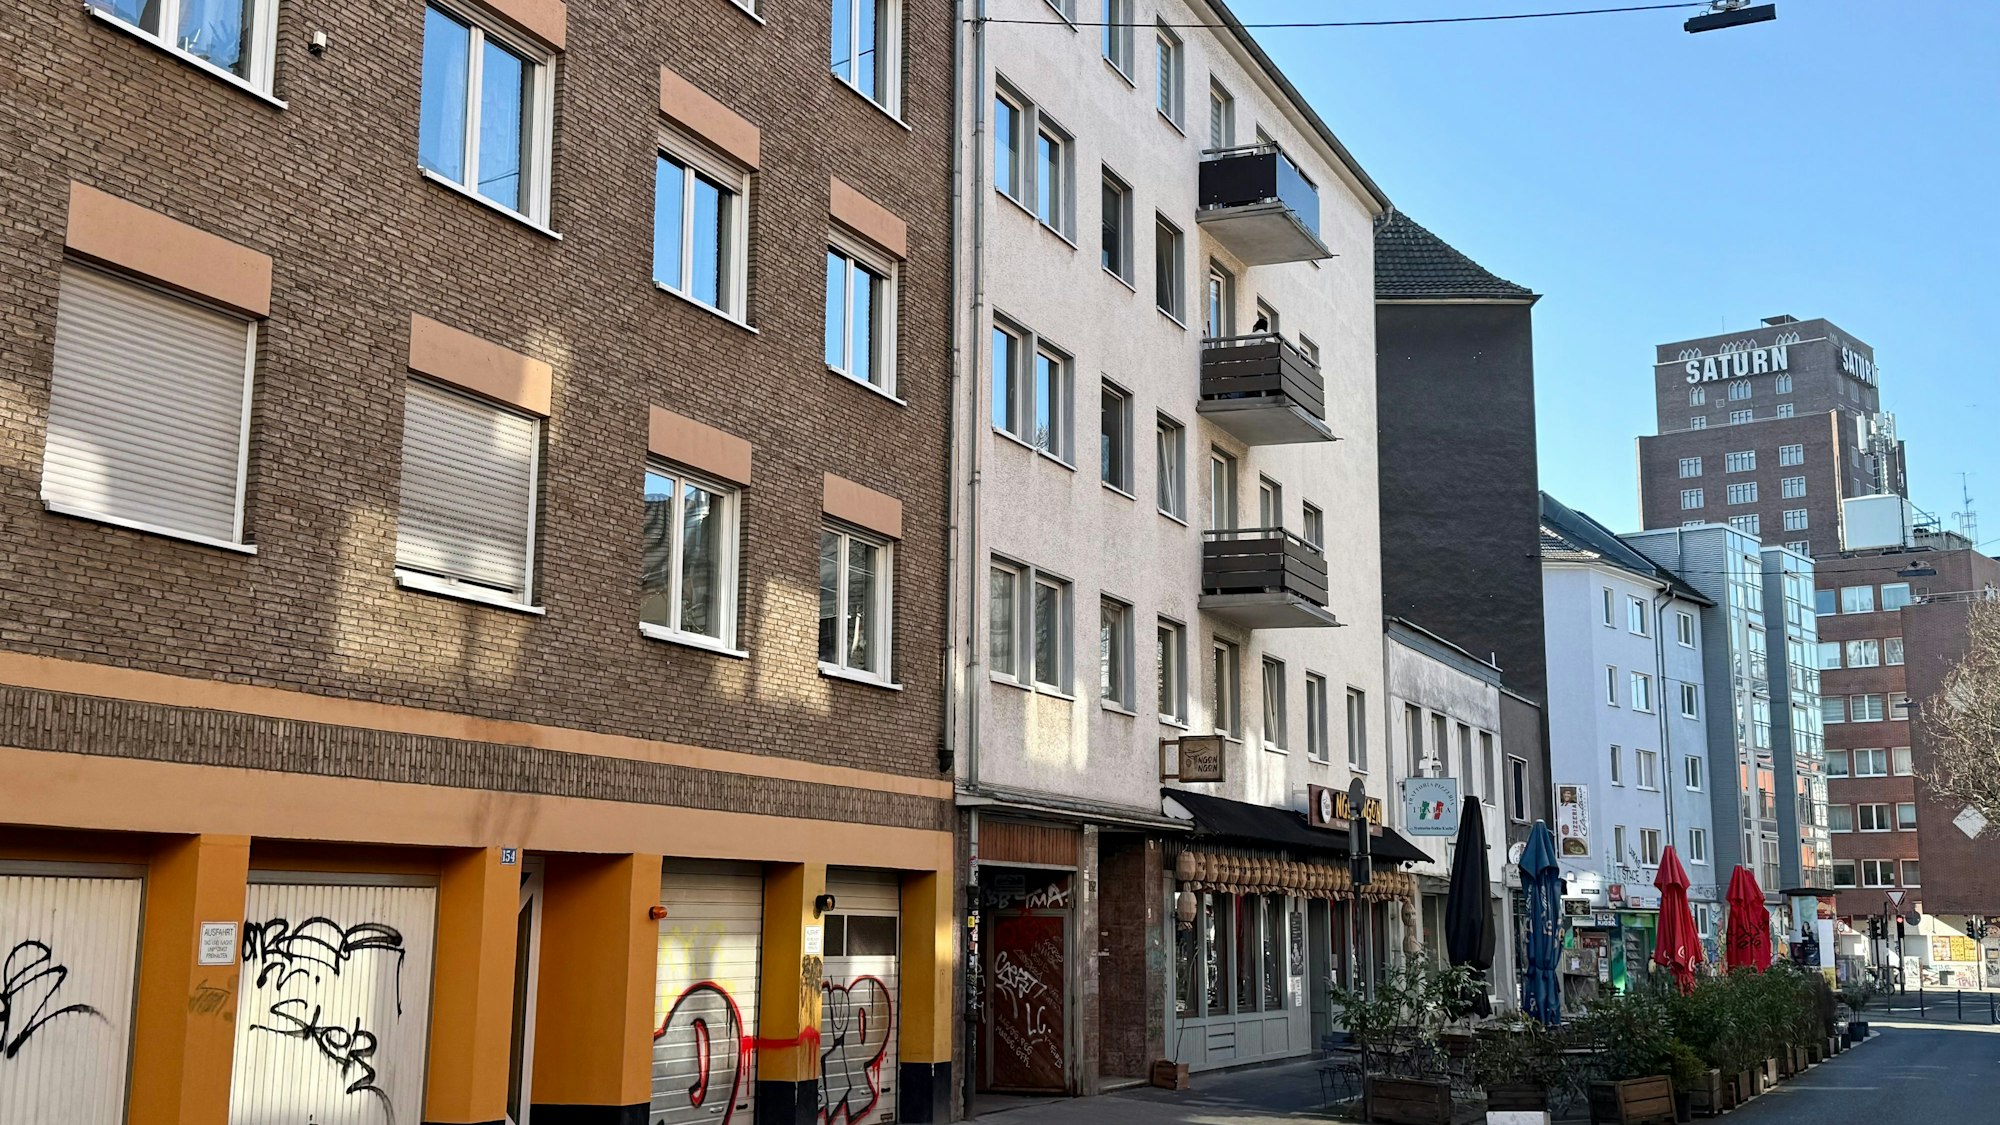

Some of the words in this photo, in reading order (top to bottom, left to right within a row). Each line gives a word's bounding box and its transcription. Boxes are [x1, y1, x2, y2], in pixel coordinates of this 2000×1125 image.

[1685, 345, 1788, 384] SATURN
[1841, 346, 1879, 388] SATURN
[1335, 791, 1351, 821] NG
[1571, 803, 1579, 837] PIZZERIA
[502, 850, 516, 863] 154
[204, 927, 234, 937] AUSFAHRT
